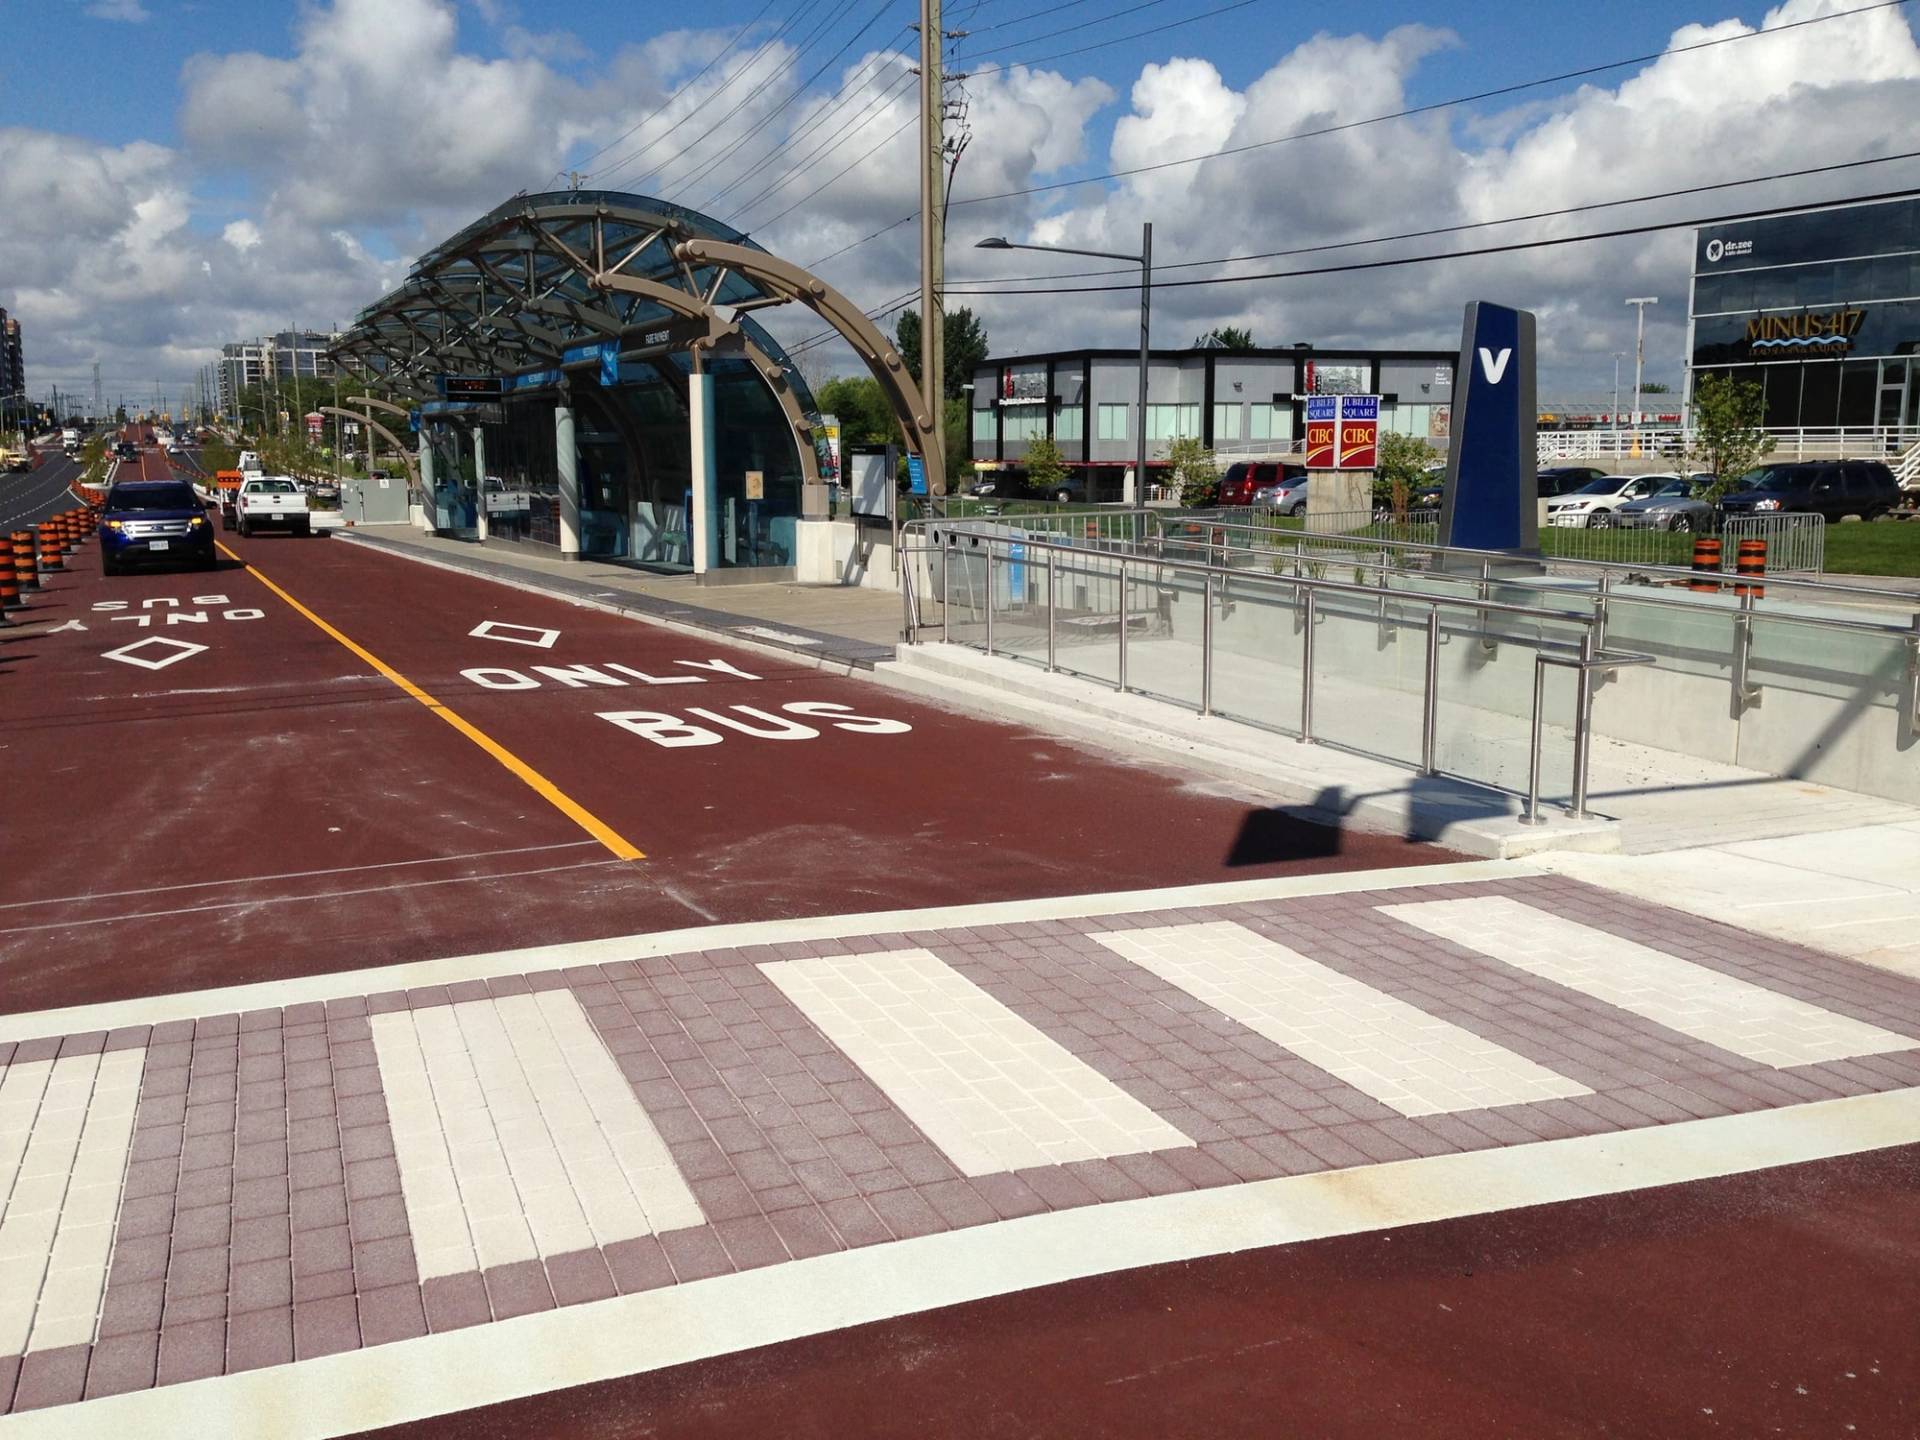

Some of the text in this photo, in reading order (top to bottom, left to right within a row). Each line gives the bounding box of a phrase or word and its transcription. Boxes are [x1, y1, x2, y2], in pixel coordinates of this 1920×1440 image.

[1343, 397, 1376, 407] JUBILEE
[1309, 408, 1335, 419] SQUARE
[1343, 408, 1375, 418] SQUARE
[1308, 428, 1334, 443] CIBC
[1343, 428, 1375, 443] CIBC
[91, 595, 231, 611] BUS
[47, 609, 266, 633] ONLY
[459, 659, 764, 690] ONLY
[593, 701, 913, 748] BUS
